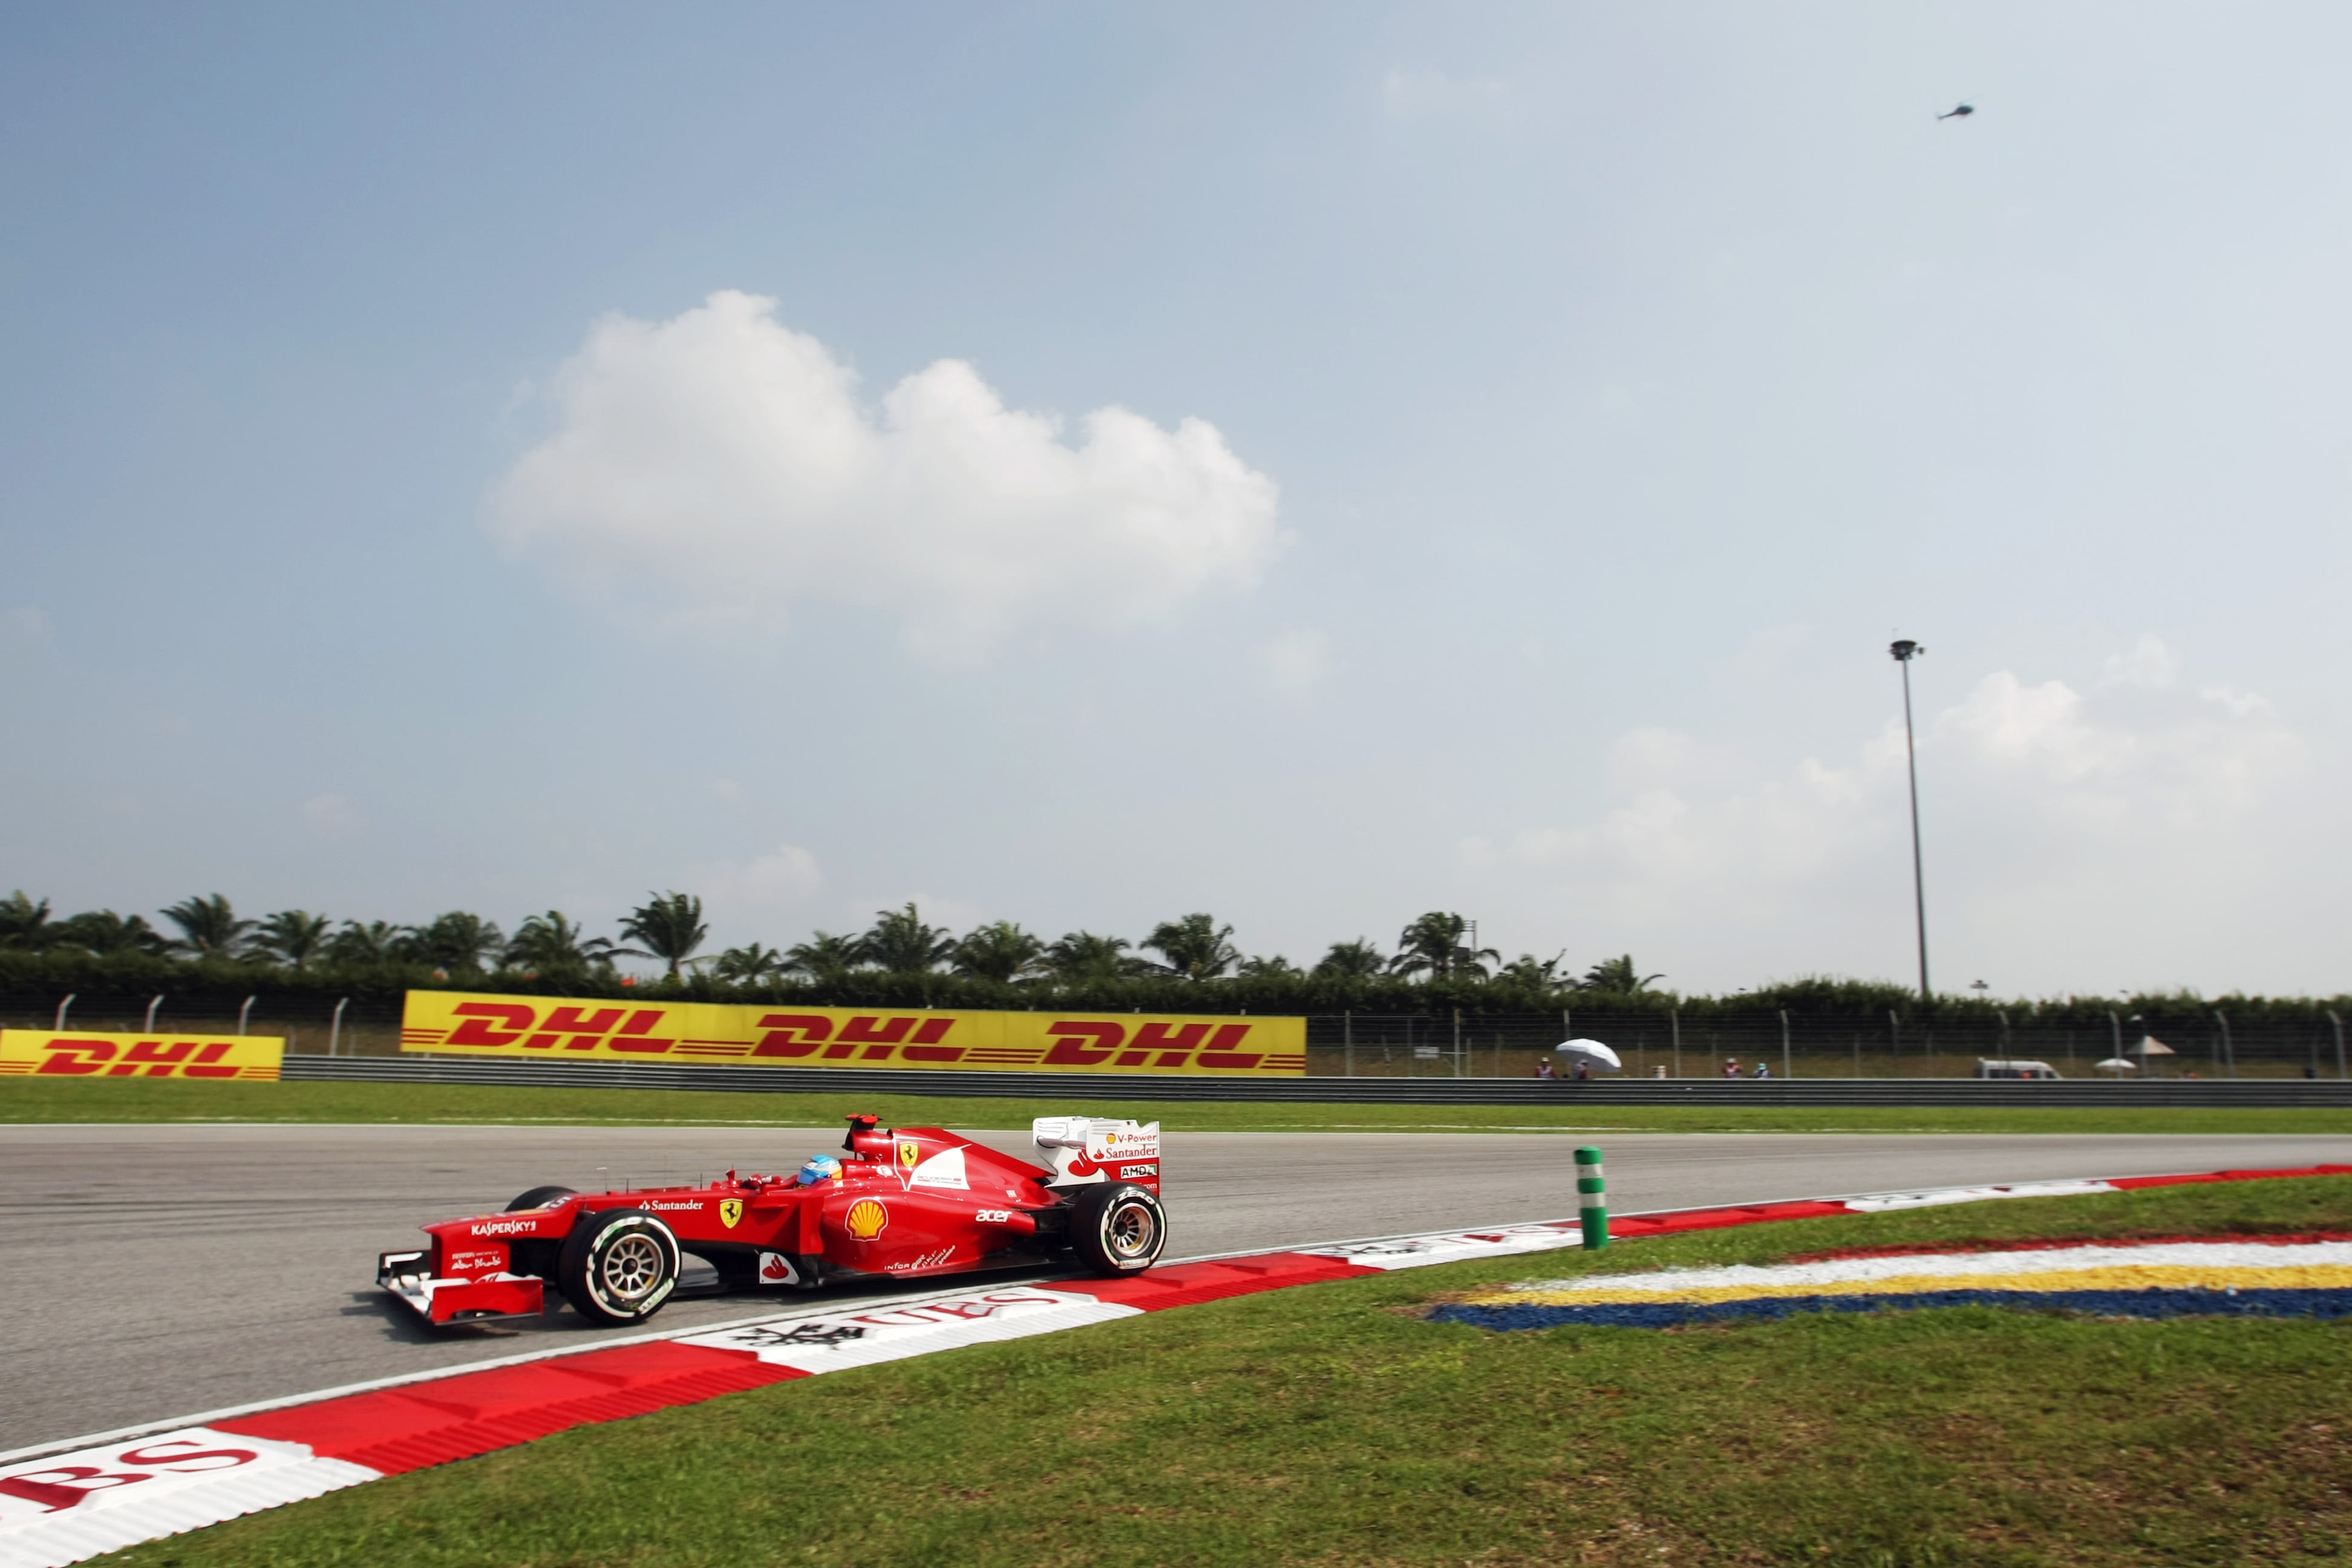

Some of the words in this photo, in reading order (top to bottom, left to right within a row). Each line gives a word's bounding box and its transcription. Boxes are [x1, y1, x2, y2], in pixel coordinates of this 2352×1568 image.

[444, 1002, 676, 1053] DHL
[750, 1014, 966, 1062] DHL
[36, 1039, 243, 1078] DHL
[1042, 1021, 1264, 1069] DHL
[1106, 1144, 1157, 1159] Santander
[1117, 1134, 1157, 1143] V-Power
[1122, 1166, 1147, 1177] AMD
[652, 1200, 704, 1210] Santander
[975, 1209, 1013, 1222] acer
[841, 1293, 1060, 1325] UBS
[0, 1440, 258, 1514] BS
